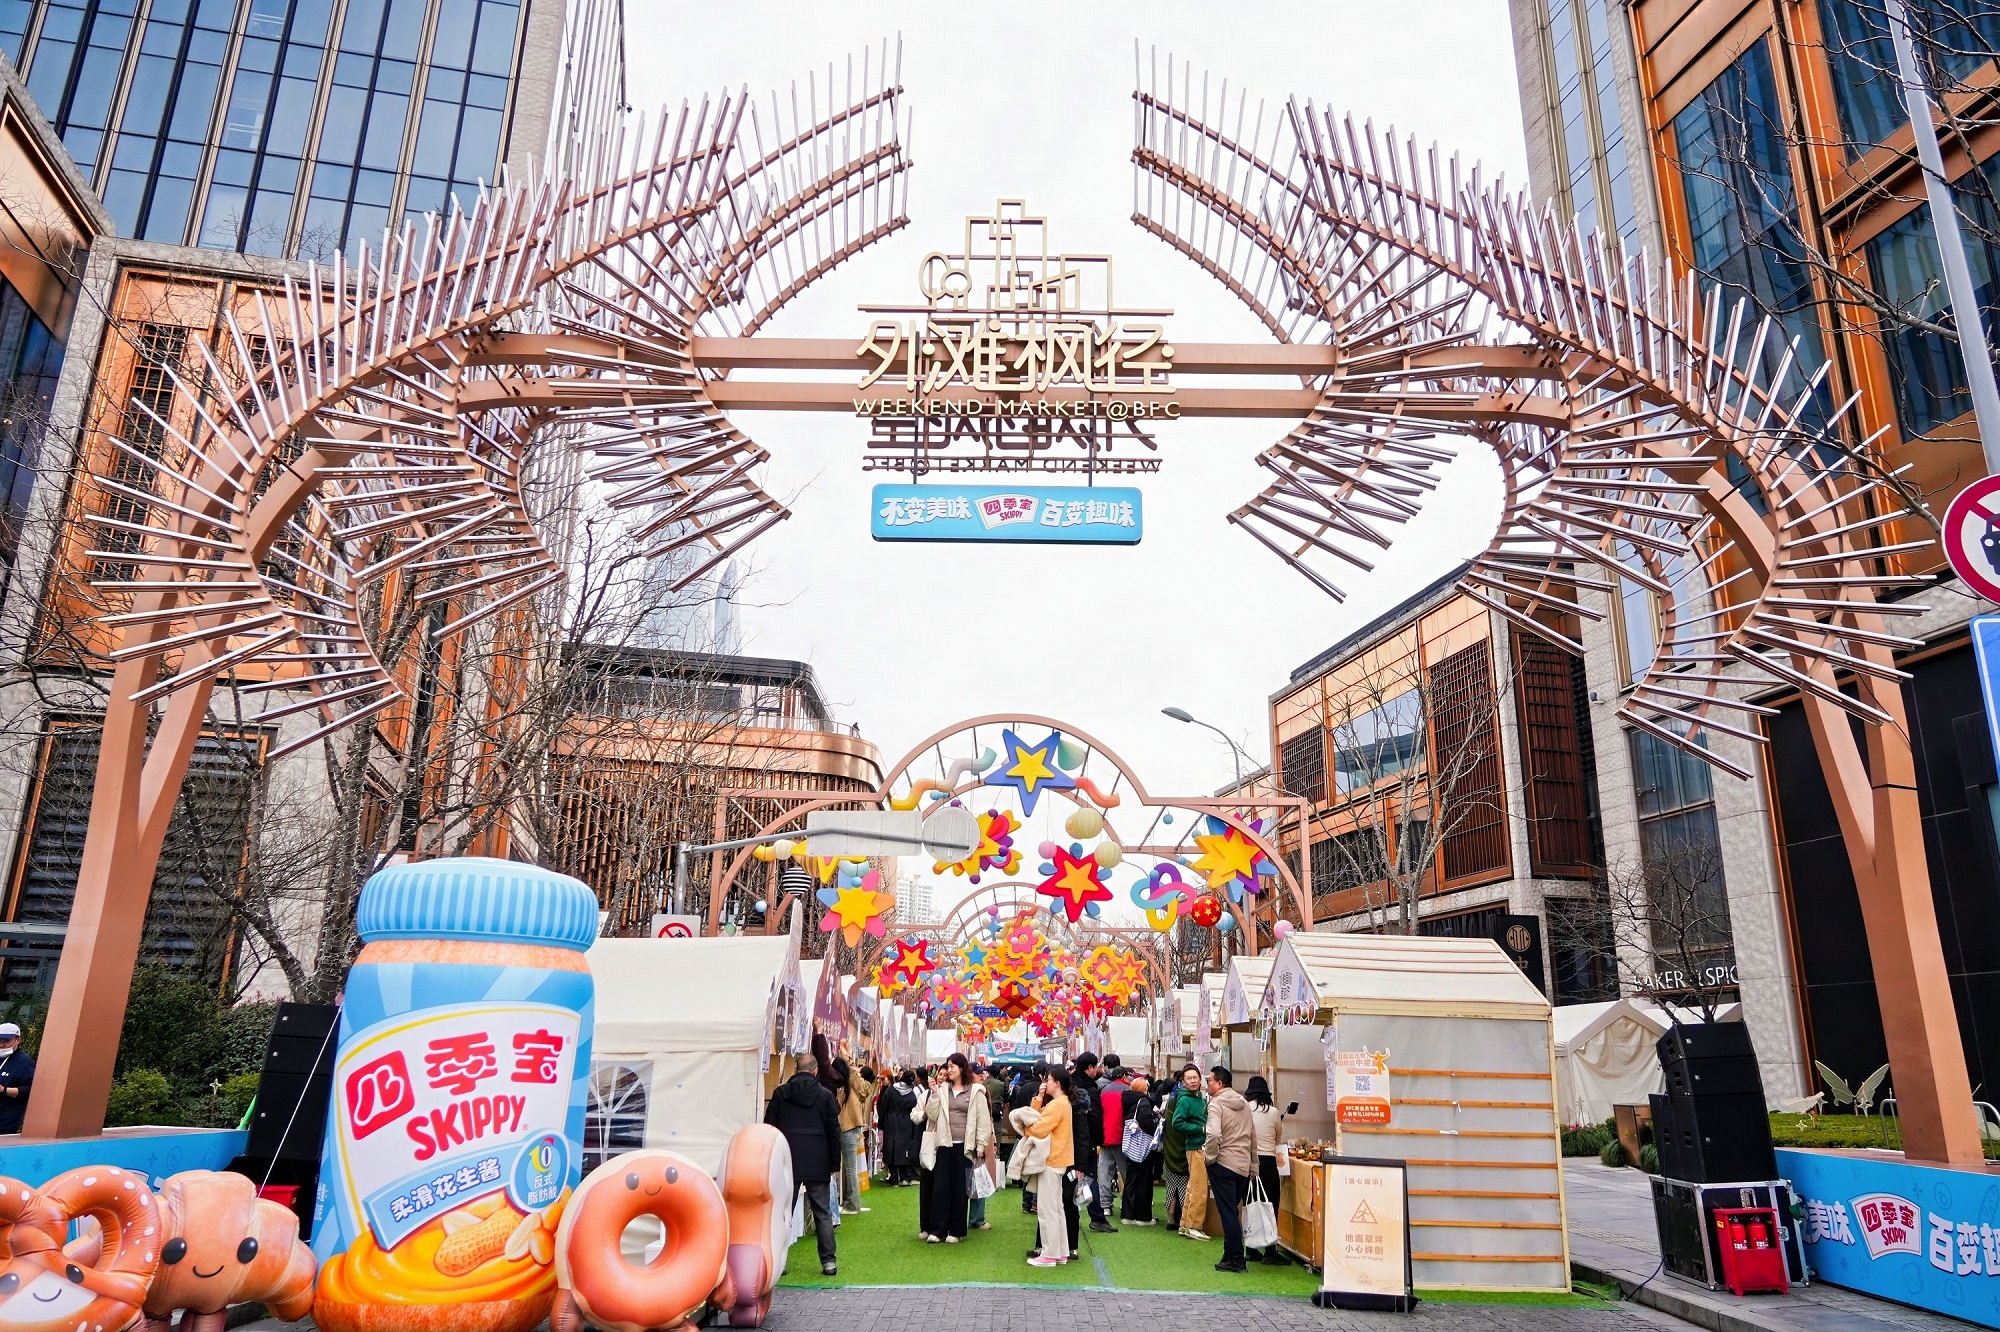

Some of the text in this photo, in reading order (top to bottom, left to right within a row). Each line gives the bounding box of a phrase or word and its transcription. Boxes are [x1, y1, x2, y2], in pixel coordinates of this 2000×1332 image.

[856, 319, 1177, 394] 外滩枫径
[853, 398, 983, 416] WEEKEND
[880, 495, 1136, 528] 不变美味 四季宝 百变趣味
[999, 510, 1023, 522] SKIPPY
[346, 1029, 564, 1140] 四季宝
[405, 1095, 526, 1161] SKIPPY
[390, 1157, 502, 1223] 柔滑花生酱
[533, 1173, 554, 1189] 反式
[1861, 1201, 1915, 1233] 四季宝
[1345, 1233, 1384, 1245] 地面草坪
[1345, 1244, 1384, 1255] 小心绊倒
[1881, 1226, 1908, 1247] SKIPPY
